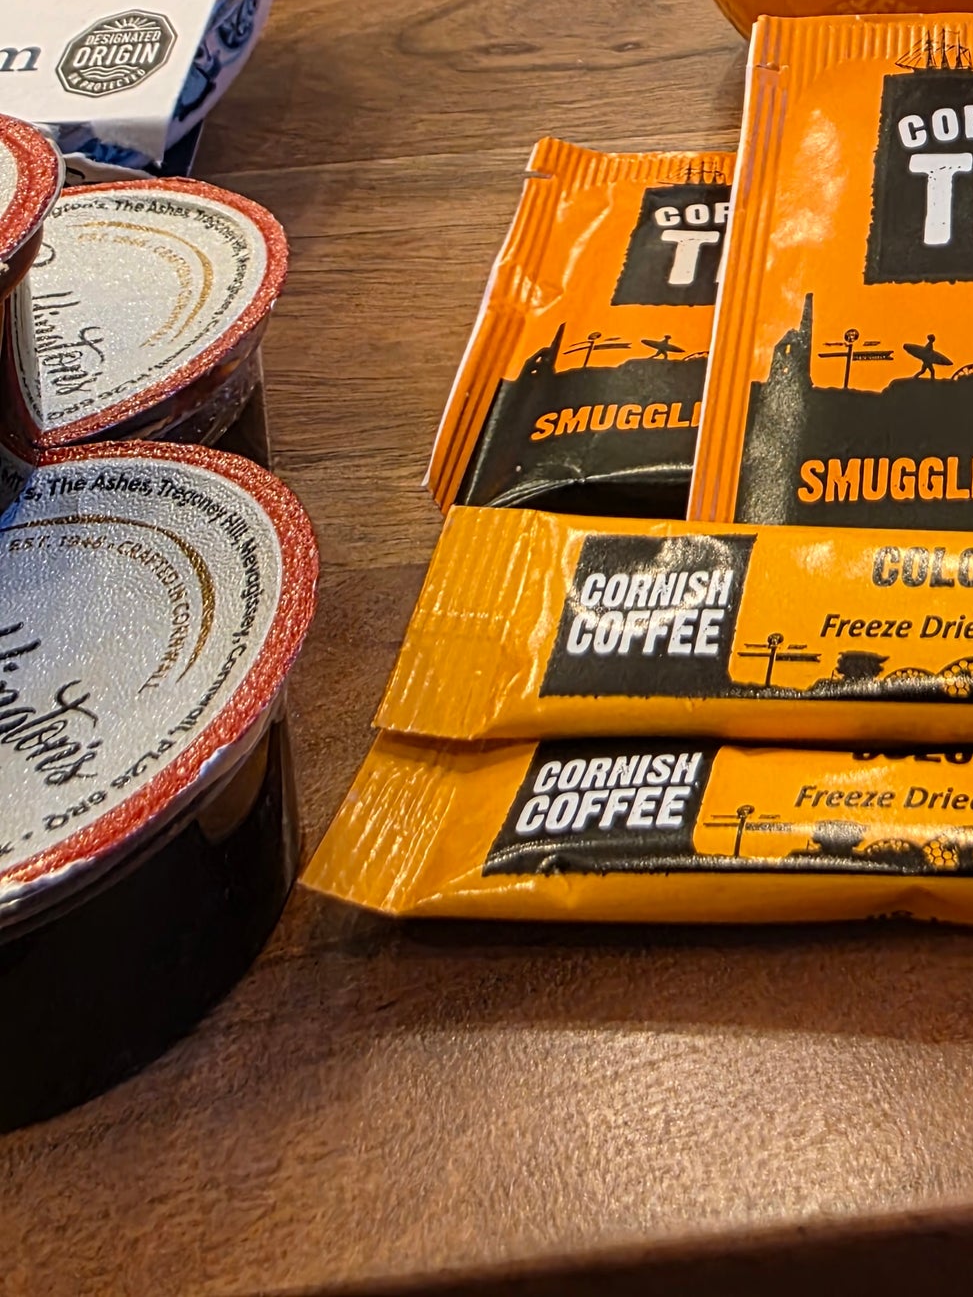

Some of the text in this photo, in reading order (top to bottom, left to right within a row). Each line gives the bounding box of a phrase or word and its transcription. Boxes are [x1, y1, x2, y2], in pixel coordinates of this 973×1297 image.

[85, 30, 161, 46] DESIGNATED
[73, 43, 160, 67] ORIGIN
[80, 69, 146, 91] PROTECTED
[115, 200, 145, 213] The
[530, 402, 702, 441] SMUGGL
[47, 476, 86, 497] The
[90, 473, 153, 497] Ashes,
[580, 570, 733, 608] CORNISH
[566, 609, 724, 655] COFFEE
[820, 613, 913, 638] Freeze
[533, 752, 703, 793] CORNISH
[795, 784, 896, 809] Freeze
[515, 785, 692, 836] COFFEE
